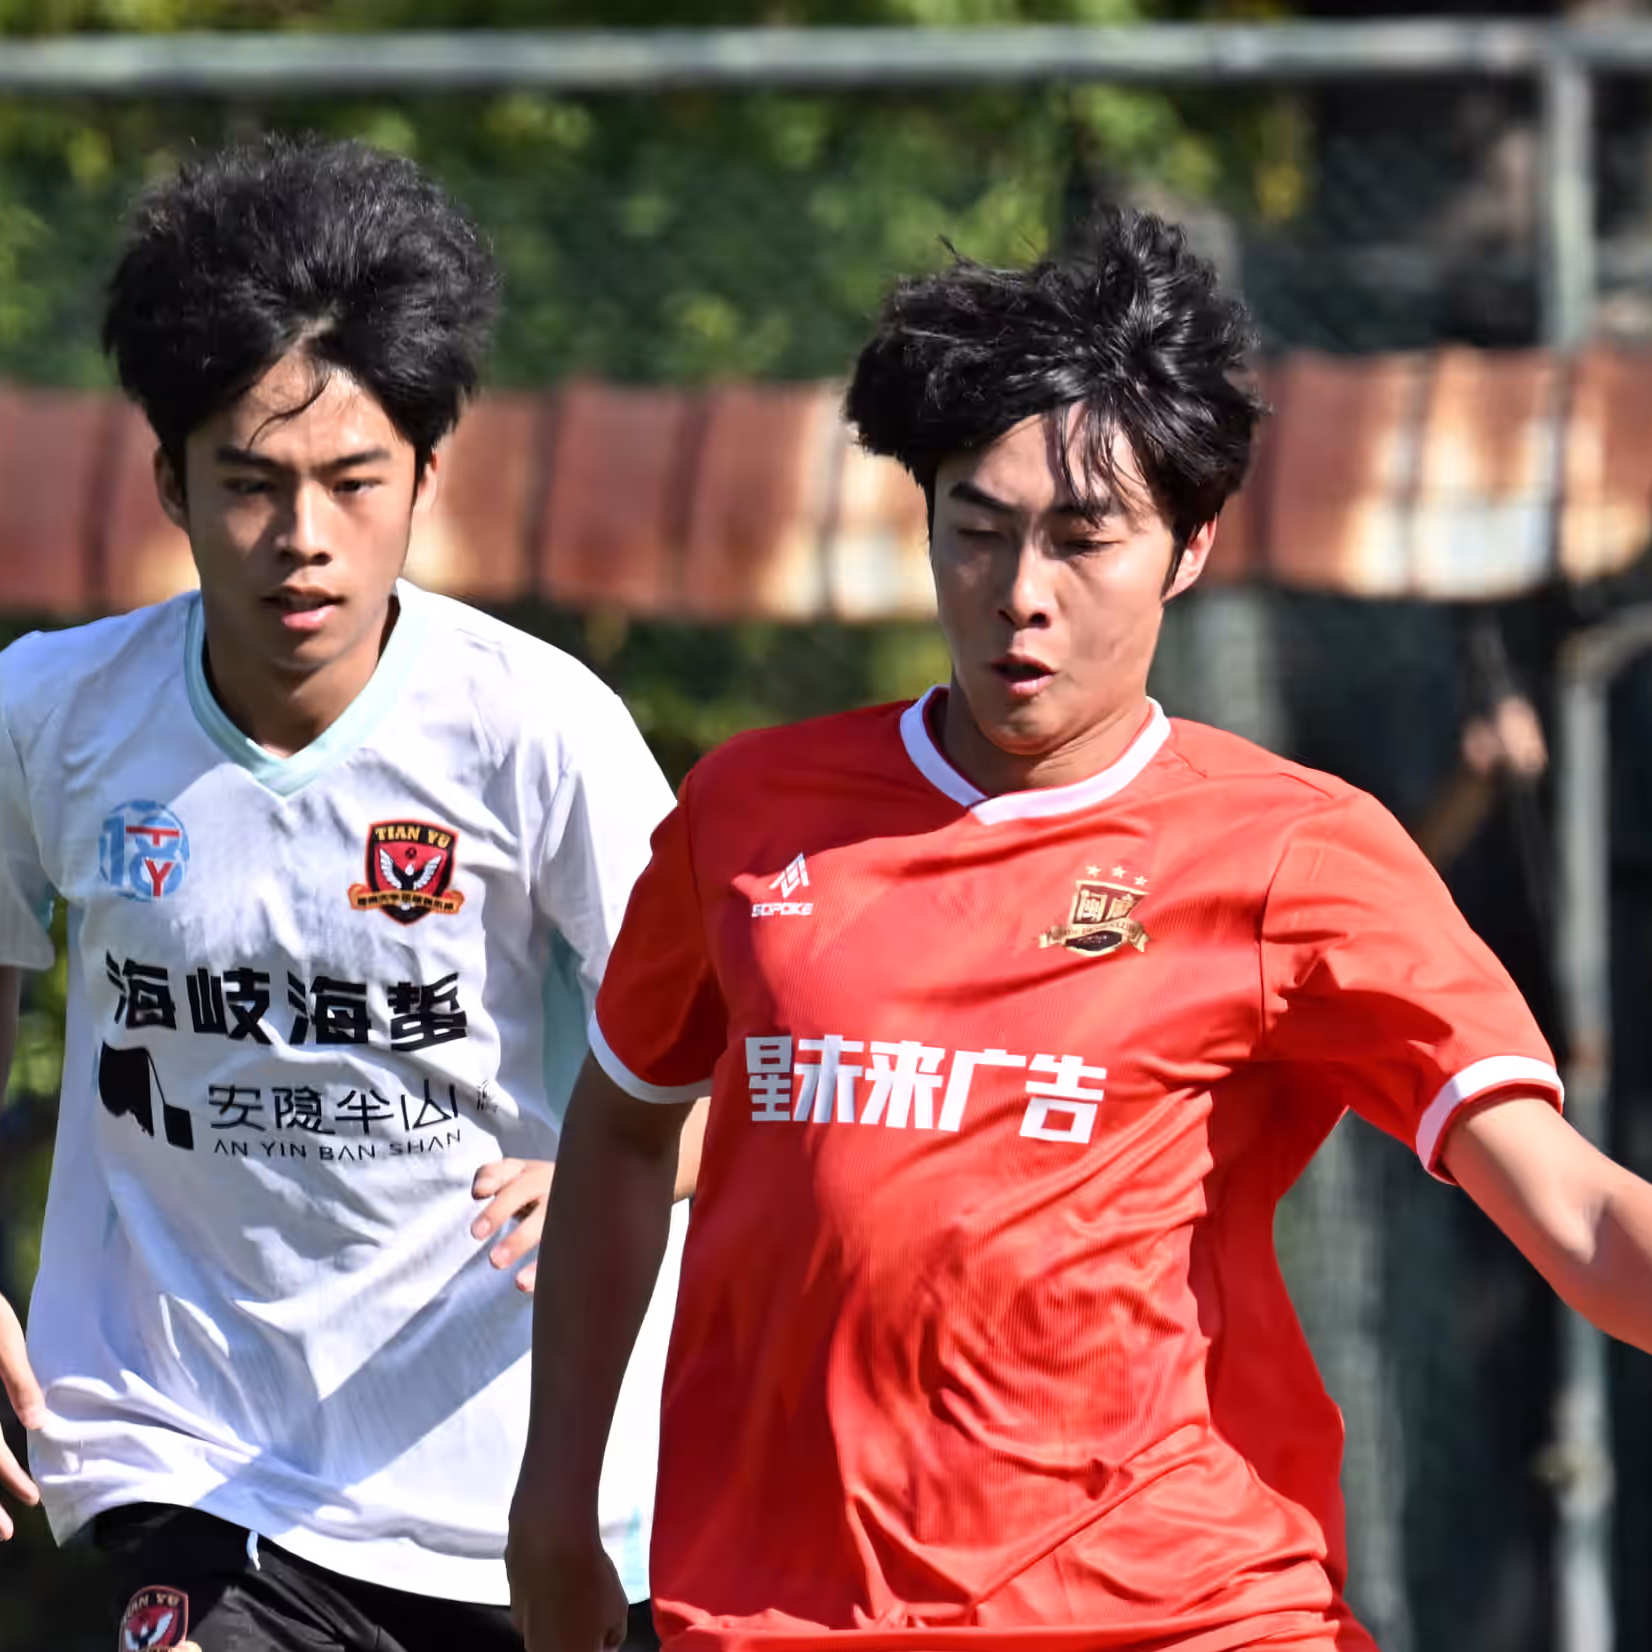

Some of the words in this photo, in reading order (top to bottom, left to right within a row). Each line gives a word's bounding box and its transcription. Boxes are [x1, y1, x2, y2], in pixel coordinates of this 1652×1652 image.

[375, 825, 420, 841] TIAN
[428, 830, 451, 848] YU
[745, 1034, 1107, 1144] 星未来广告
[213, 1139, 248, 1157] AN
[261, 1142, 306, 1158] YIN
[319, 1145, 375, 1161] BAN
[390, 1129, 461, 1156] SHAN
